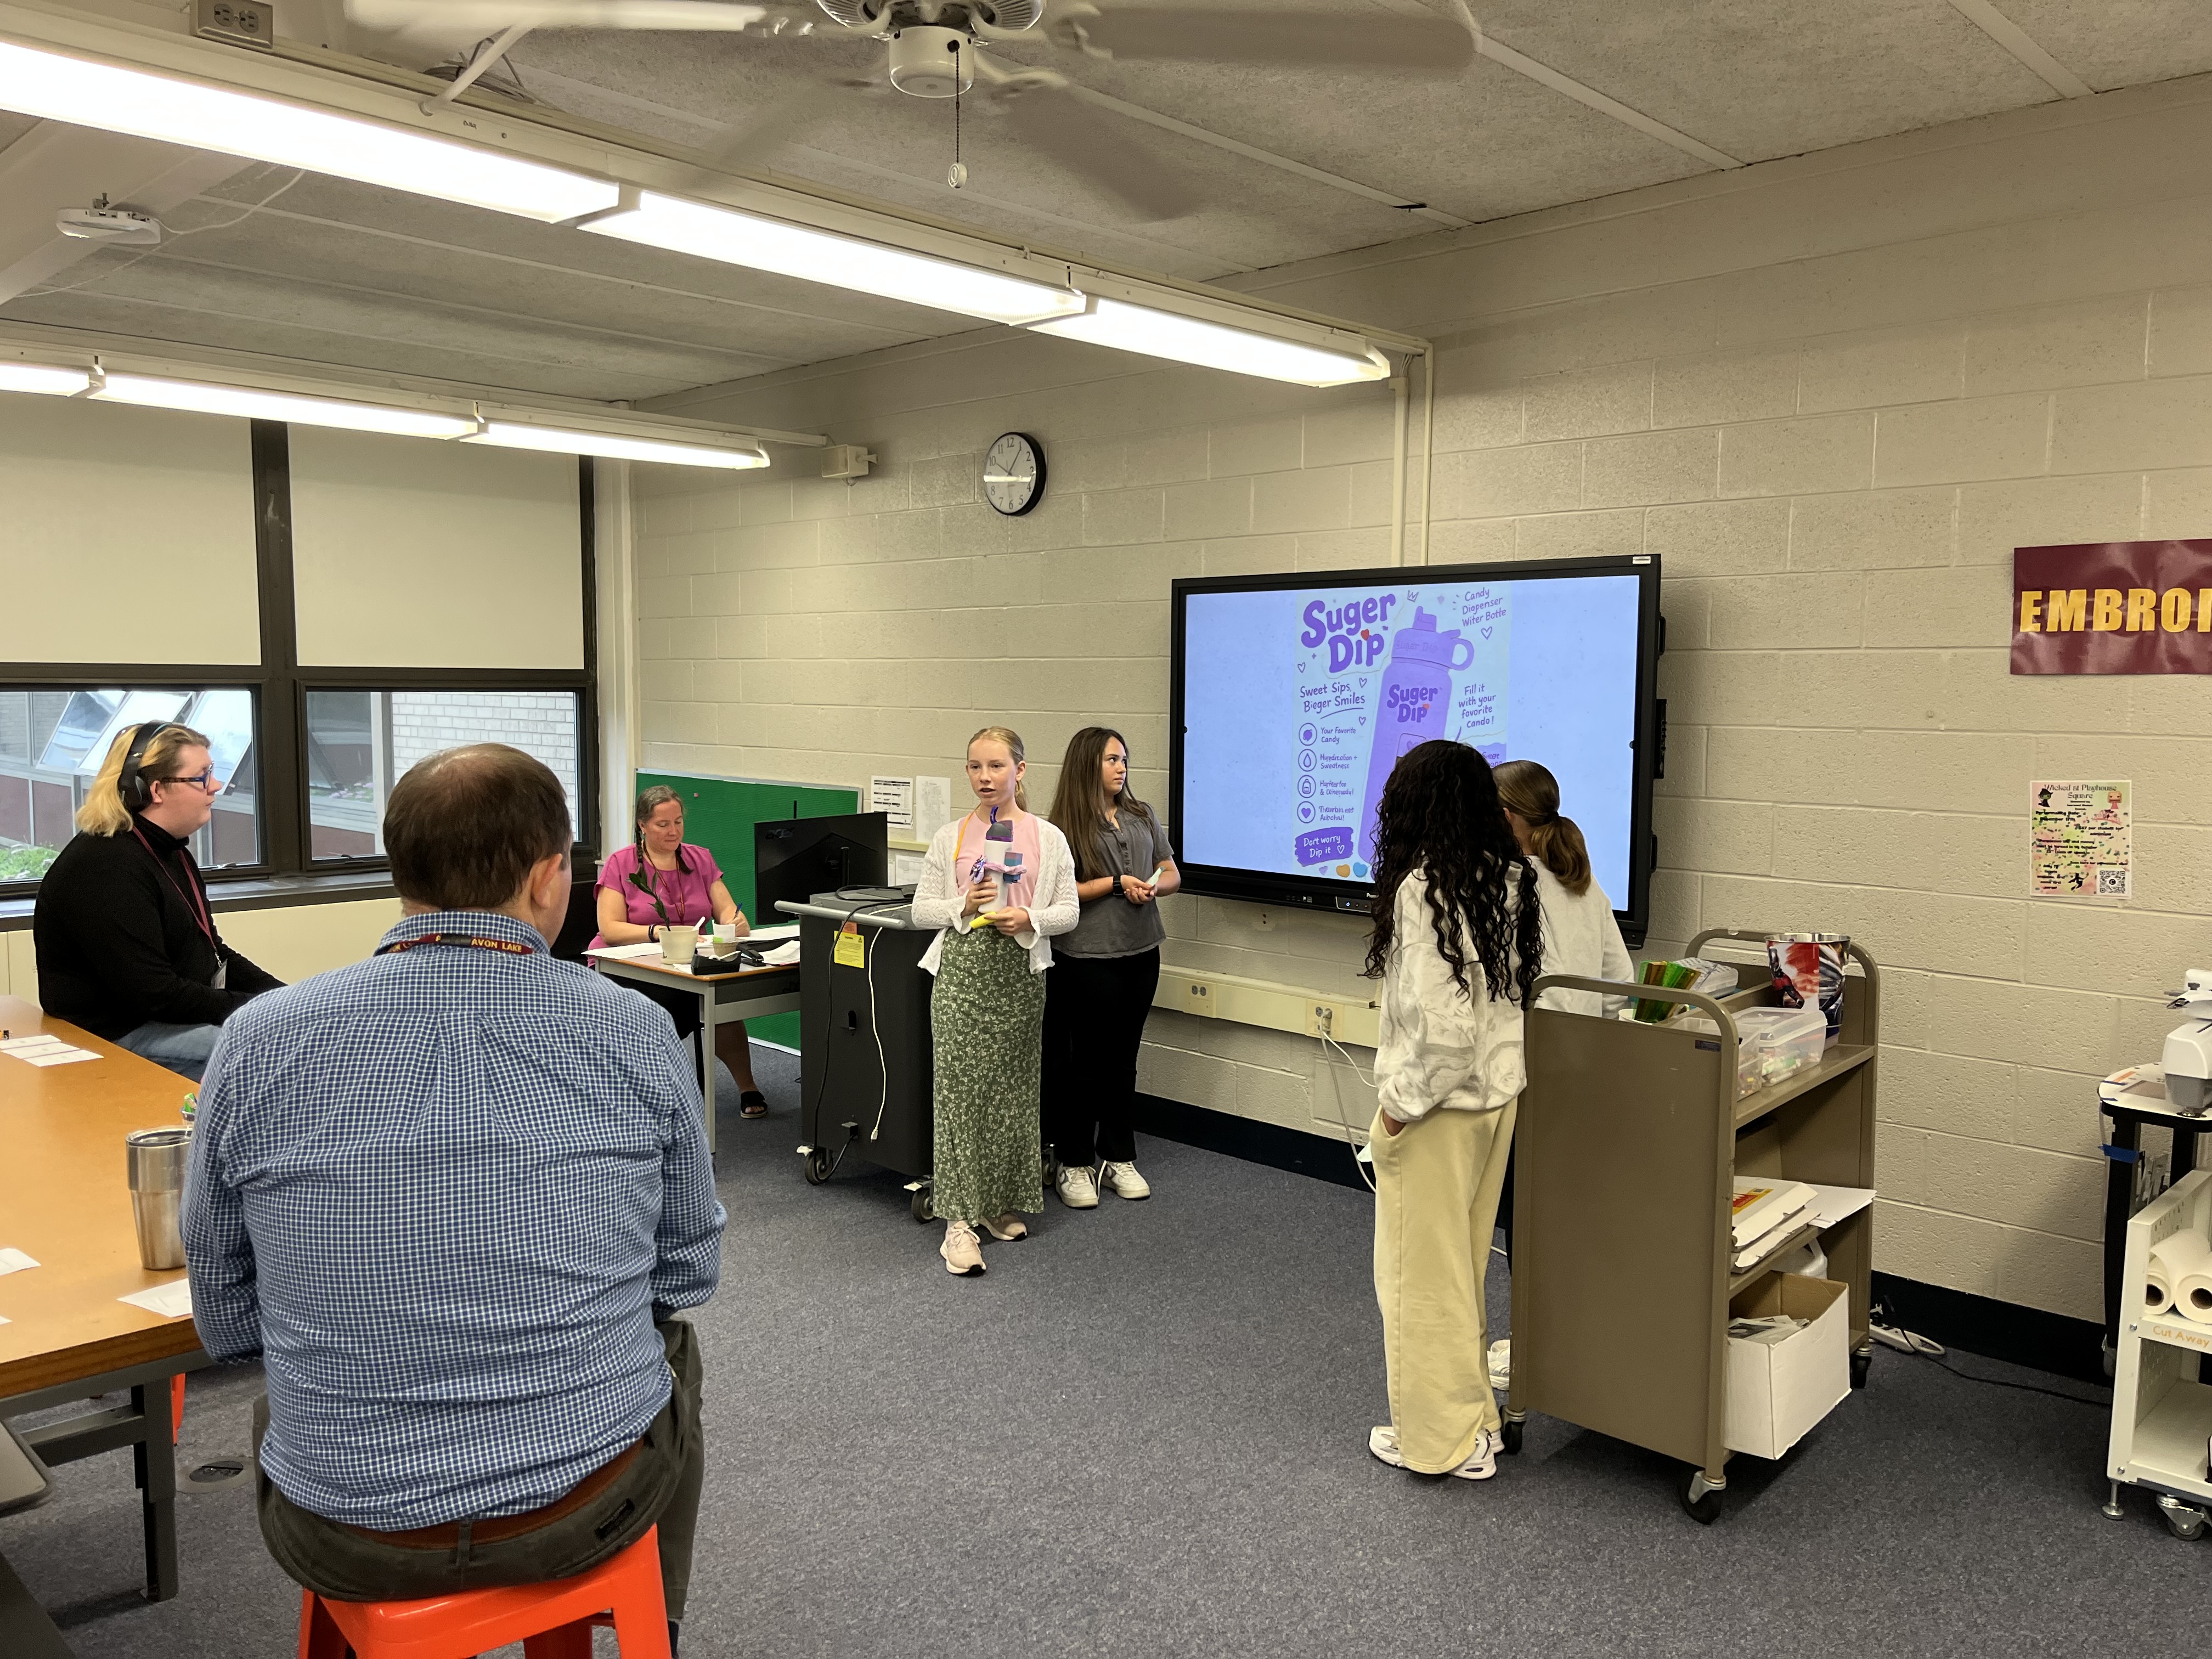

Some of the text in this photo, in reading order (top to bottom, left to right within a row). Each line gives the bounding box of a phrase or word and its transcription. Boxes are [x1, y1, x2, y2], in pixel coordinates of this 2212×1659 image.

[1007, 437, 1015, 448] 12
[989, 456, 996, 466] 10
[1026, 451, 1031, 462] 2
[991, 486, 995, 496] 8
[998, 497, 1004, 508] 7
[1008, 499, 1013, 509] 6
[1018, 495, 1024, 505] 5
[1465, 587, 1489, 601] Candy
[1301, 594, 1396, 648] Suger
[1328, 634, 1384, 673] Dip
[1300, 684, 1328, 698] Sweet
[1387, 684, 1438, 708] Suger
[1465, 684, 1485, 696] Fill it
[1334, 692, 1365, 707] Smiles
[1458, 695, 1497, 708] with your
[1397, 703, 1427, 723] Dip
[1321, 736, 1340, 745] Candy
[1321, 836, 1341, 844] worry
[1310, 848, 1323, 858] Dip
[471, 938, 522, 953] AVON LAKE
[2153, 1325, 2210, 1347] Cut Away
